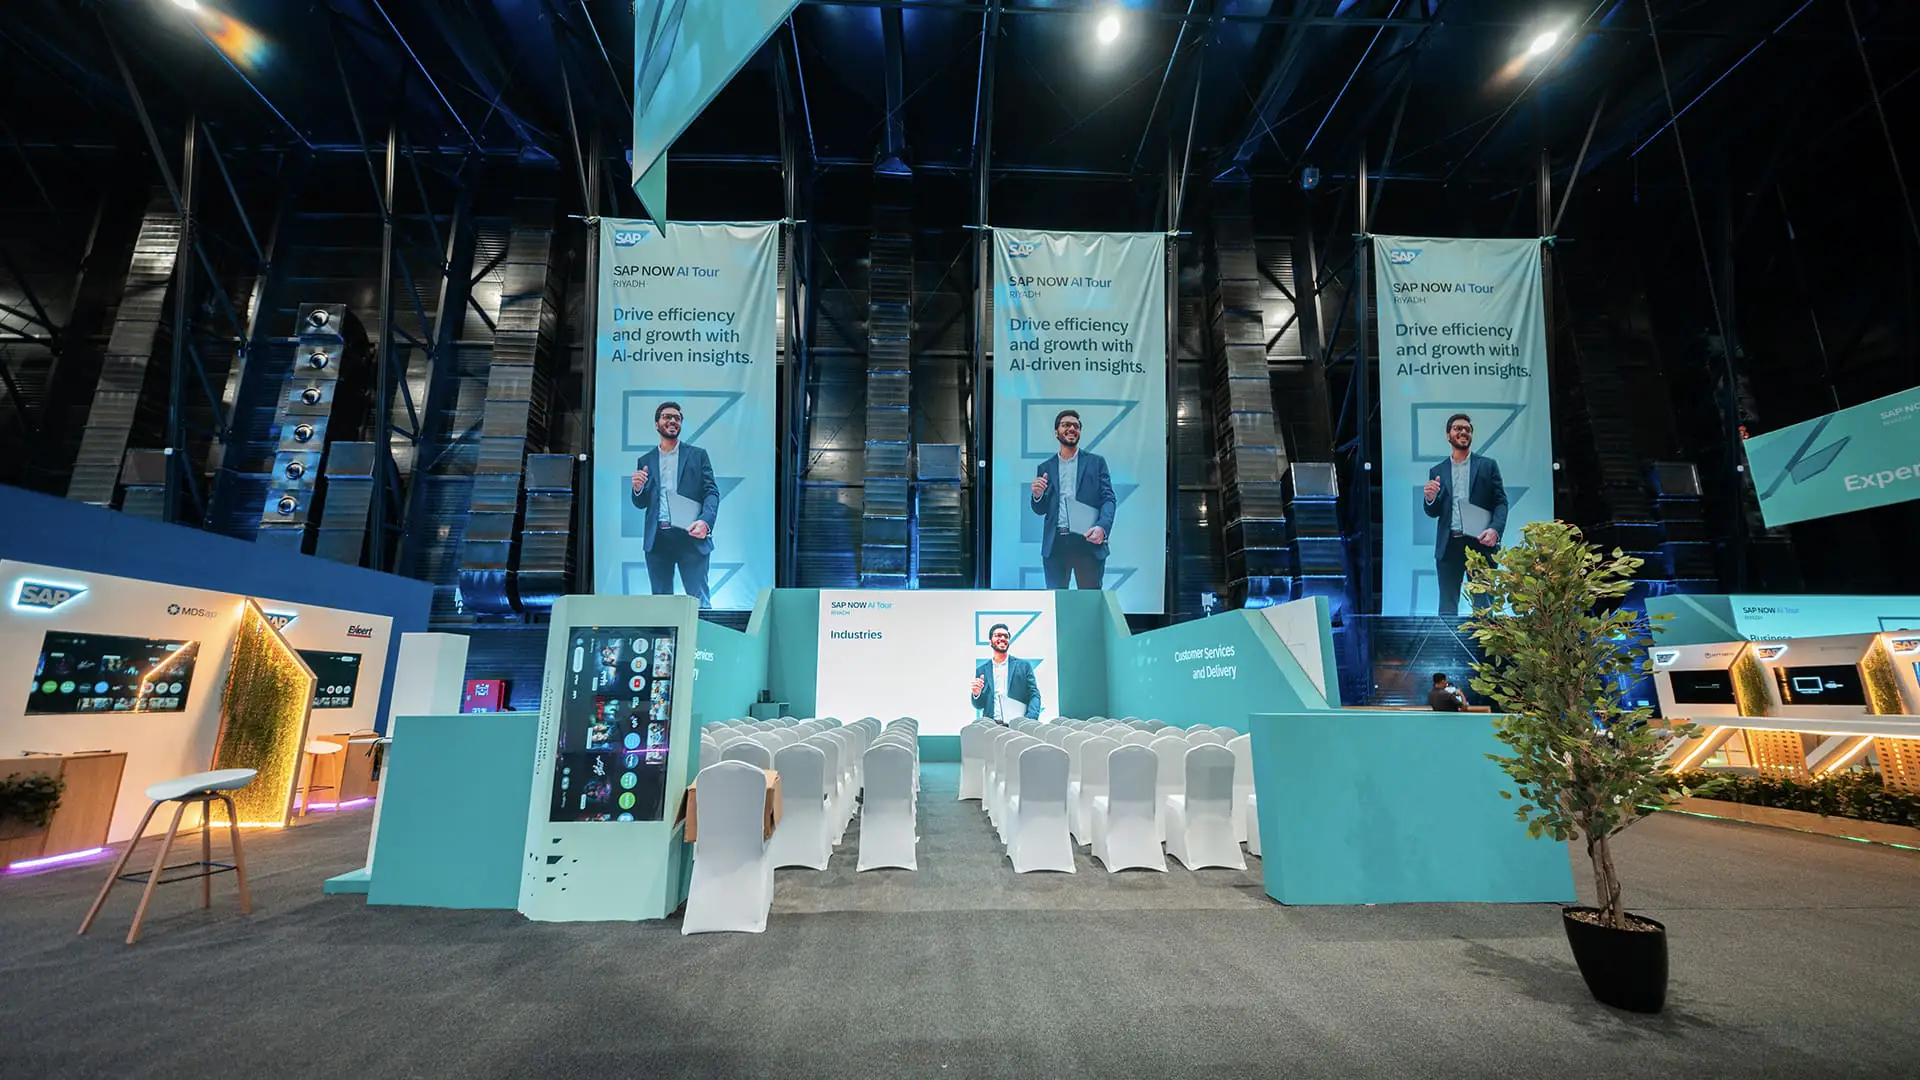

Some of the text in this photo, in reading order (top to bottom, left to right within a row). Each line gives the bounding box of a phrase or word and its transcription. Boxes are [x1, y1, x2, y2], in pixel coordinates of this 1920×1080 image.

[615, 232, 641, 244] SAP
[1009, 244, 1034, 256] SAP
[1391, 251, 1415, 262] SAP
[613, 265, 720, 278] SAP NOW AI Tour
[613, 280, 646, 288] RIYADH
[1009, 276, 1112, 288] SAP NOW AI Tour
[1393, 282, 1494, 294] SAP NOW AI Tour
[1009, 290, 1041, 298] RIYADH
[1393, 296, 1426, 304] RIYADH
[614, 307, 736, 325] Drive efficiency
[1010, 317, 1129, 336] Drive efficiency
[1396, 323, 1513, 341] Drive efficiency
[612, 328, 740, 345] and growth with
[1009, 337, 1133, 354] and growth with
[1396, 343, 1519, 359] and growth with
[612, 347, 754, 367] AI-driven insights.
[1009, 357, 1146, 376] AI-driven insights.
[1397, 363, 1532, 380] AI-driven insights.
[1880, 407, 1903, 419] SAP
[21, 585, 69, 605] SAP
[831, 601, 893, 609] SAP NOW AI Tour
[830, 630, 882, 639] Industries
[1174, 644, 1235, 663] Customer Services
[1192, 664, 1237, 680] and Delivery
